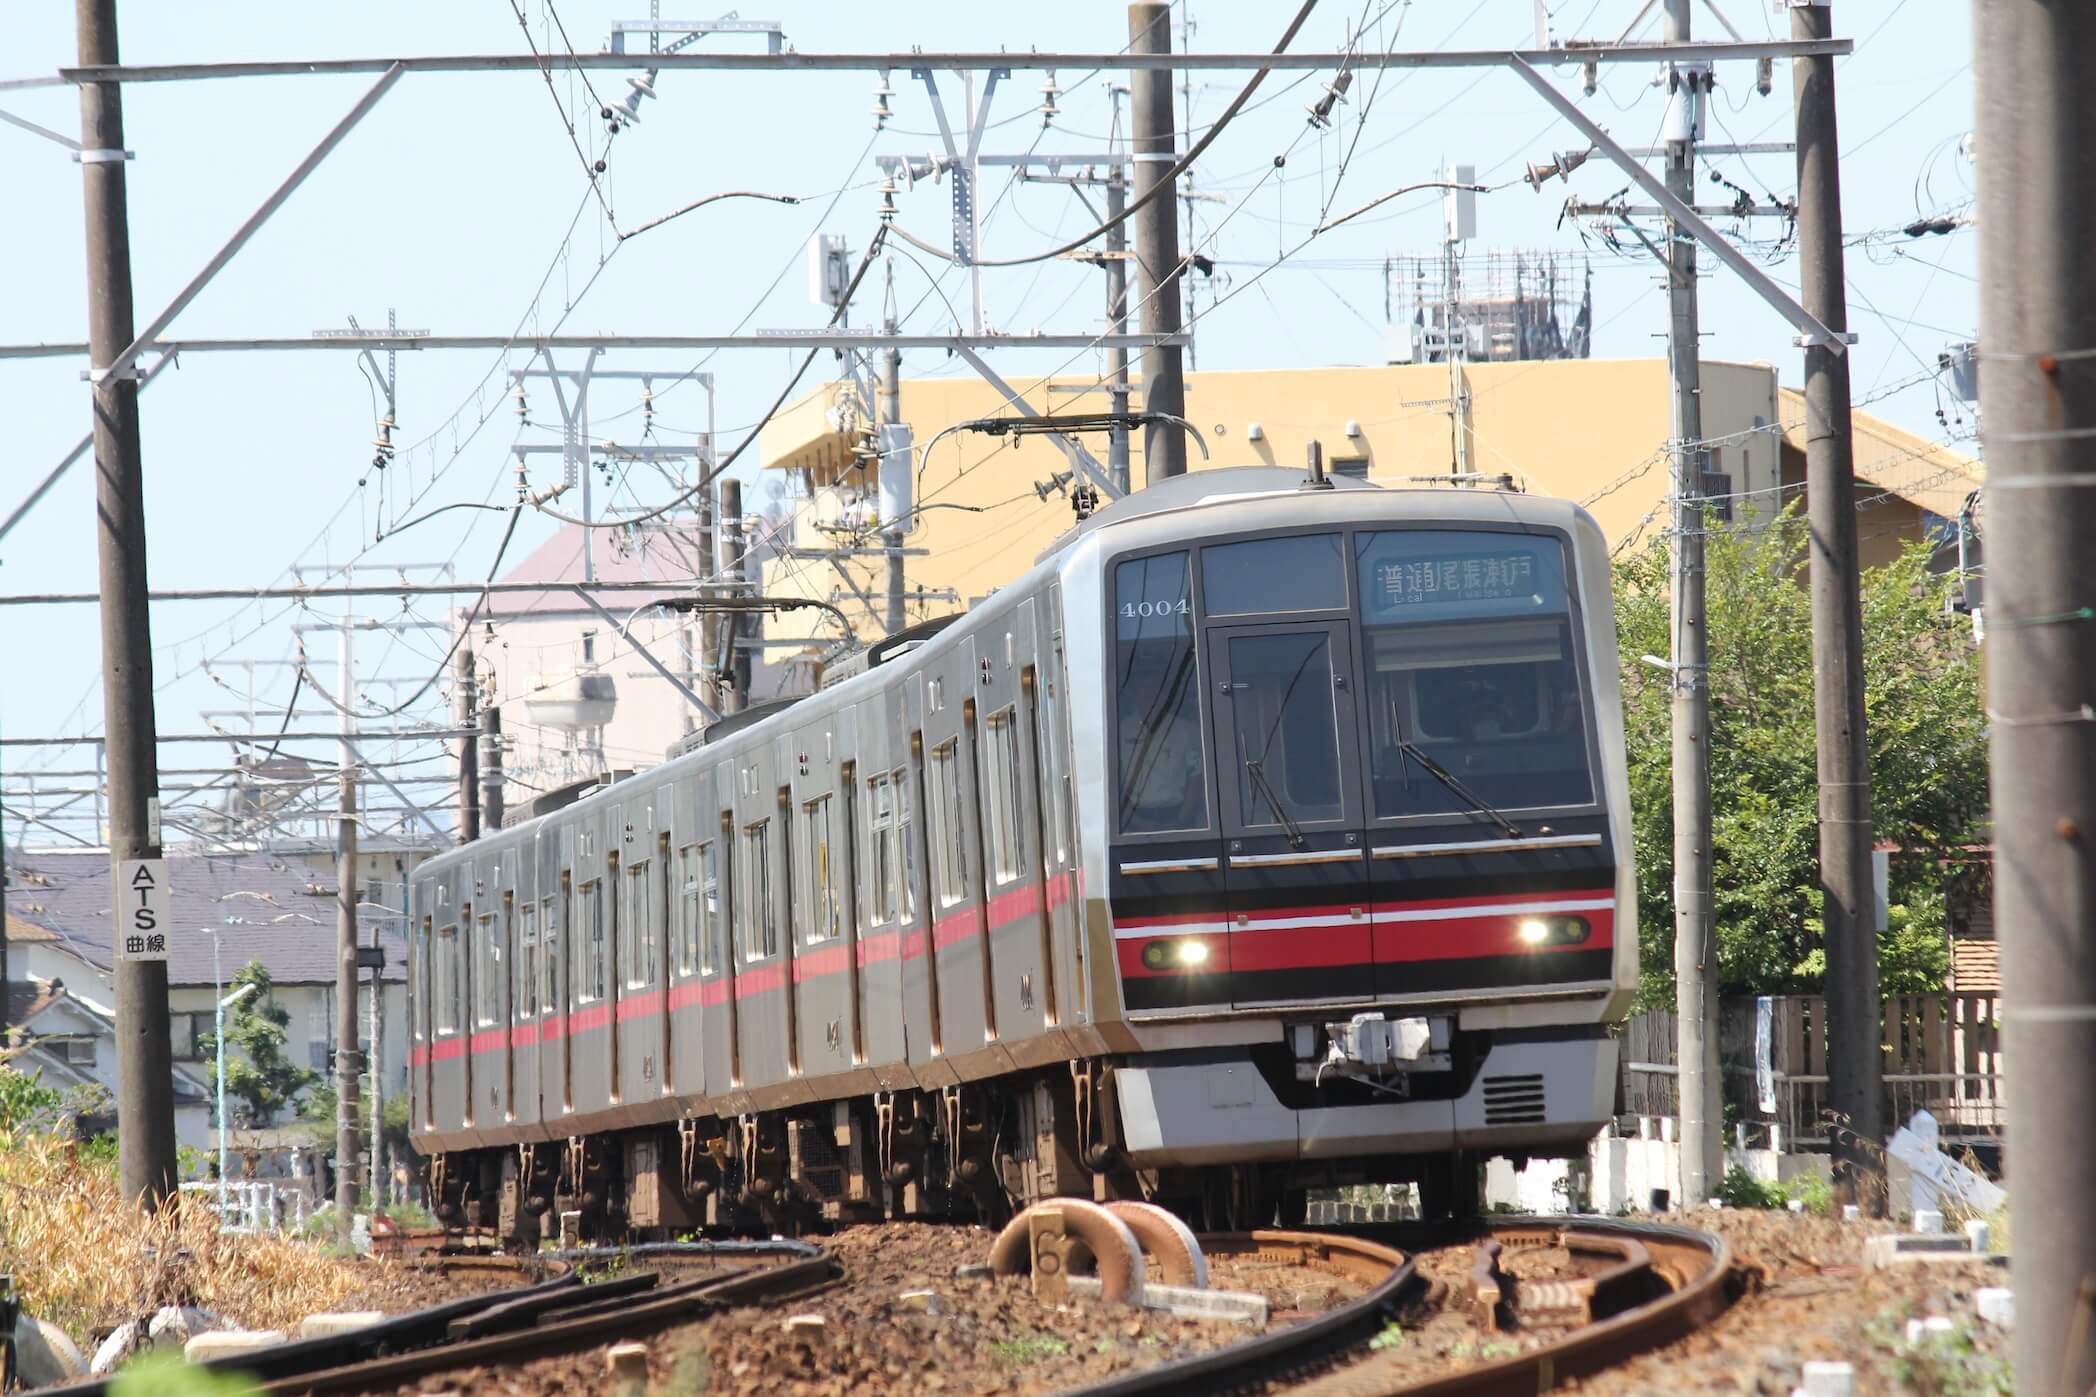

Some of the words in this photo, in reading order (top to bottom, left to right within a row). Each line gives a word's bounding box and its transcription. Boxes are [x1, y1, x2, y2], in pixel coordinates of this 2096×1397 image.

[1119, 599, 1191, 618] 4004
[131, 864, 156, 930] ATS
[126, 934, 166, 953] 曲線
[1035, 1230, 1061, 1275] 6
